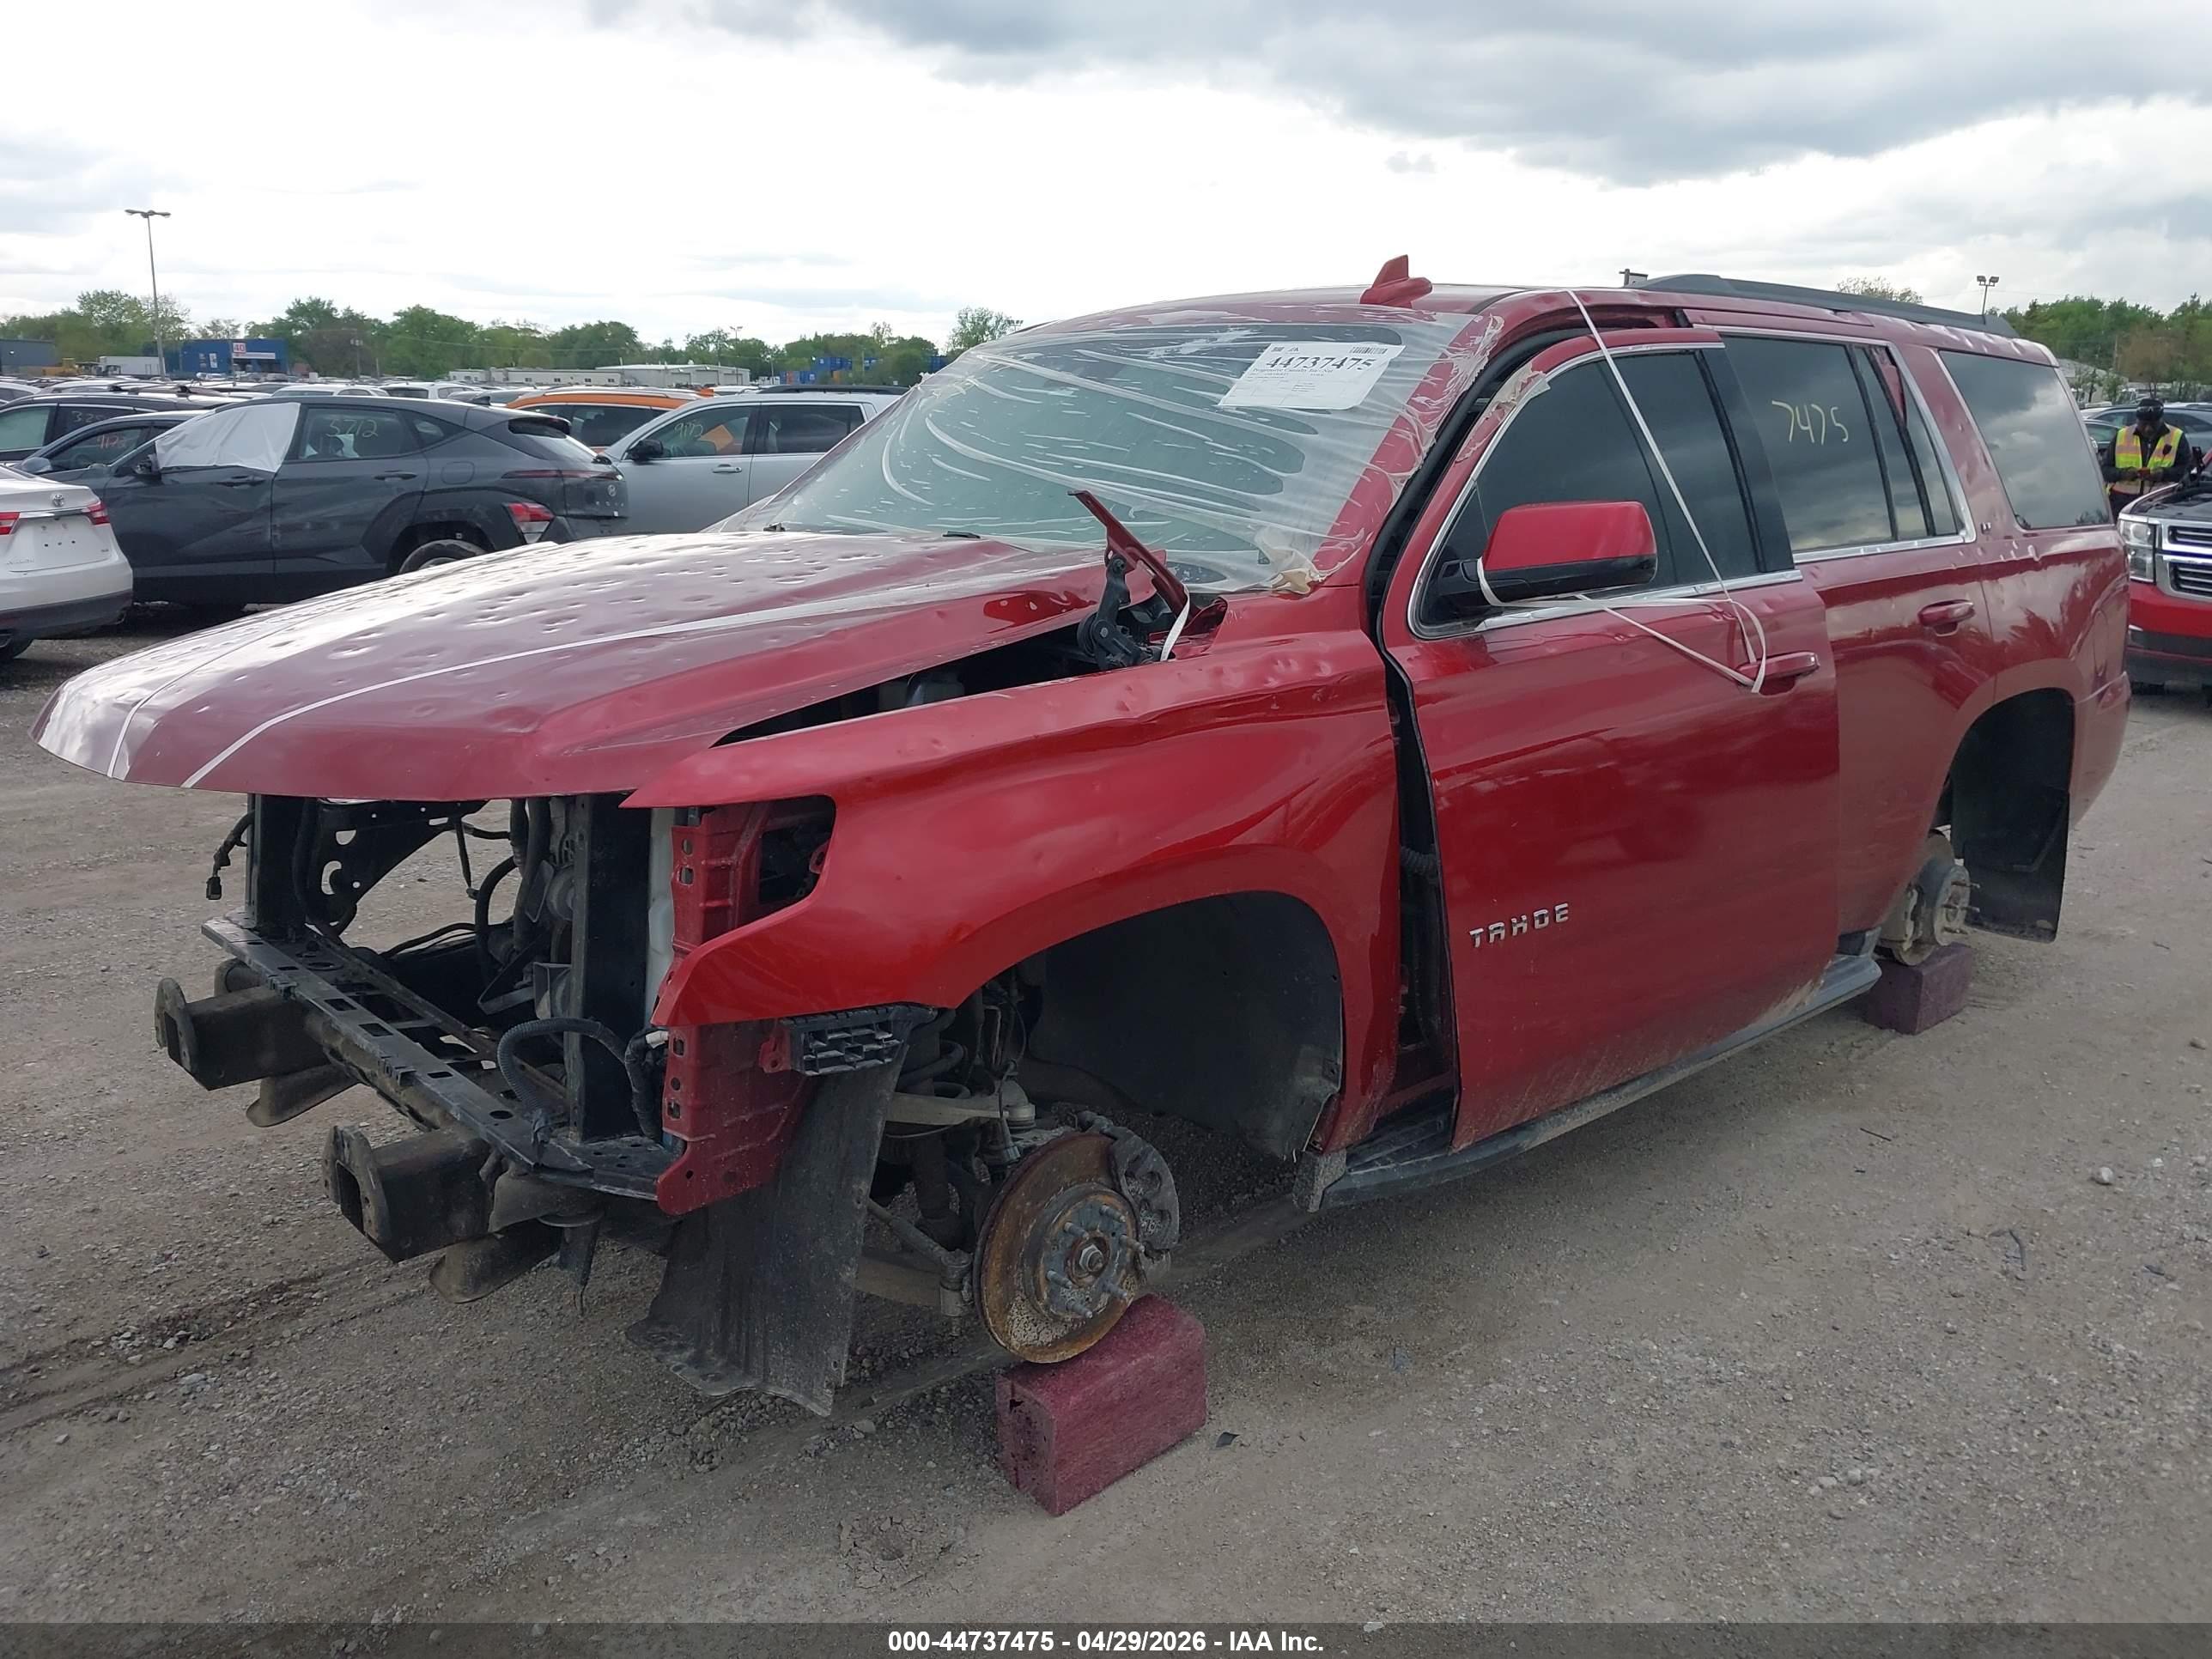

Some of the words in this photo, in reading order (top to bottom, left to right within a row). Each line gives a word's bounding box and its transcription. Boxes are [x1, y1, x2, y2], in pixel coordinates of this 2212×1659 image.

[1266, 356, 1376, 371] 44737475
[325, 419, 379, 438] 5712
[1771, 400, 1849, 445] 7475
[1469, 902, 1569, 948] TAHOE
